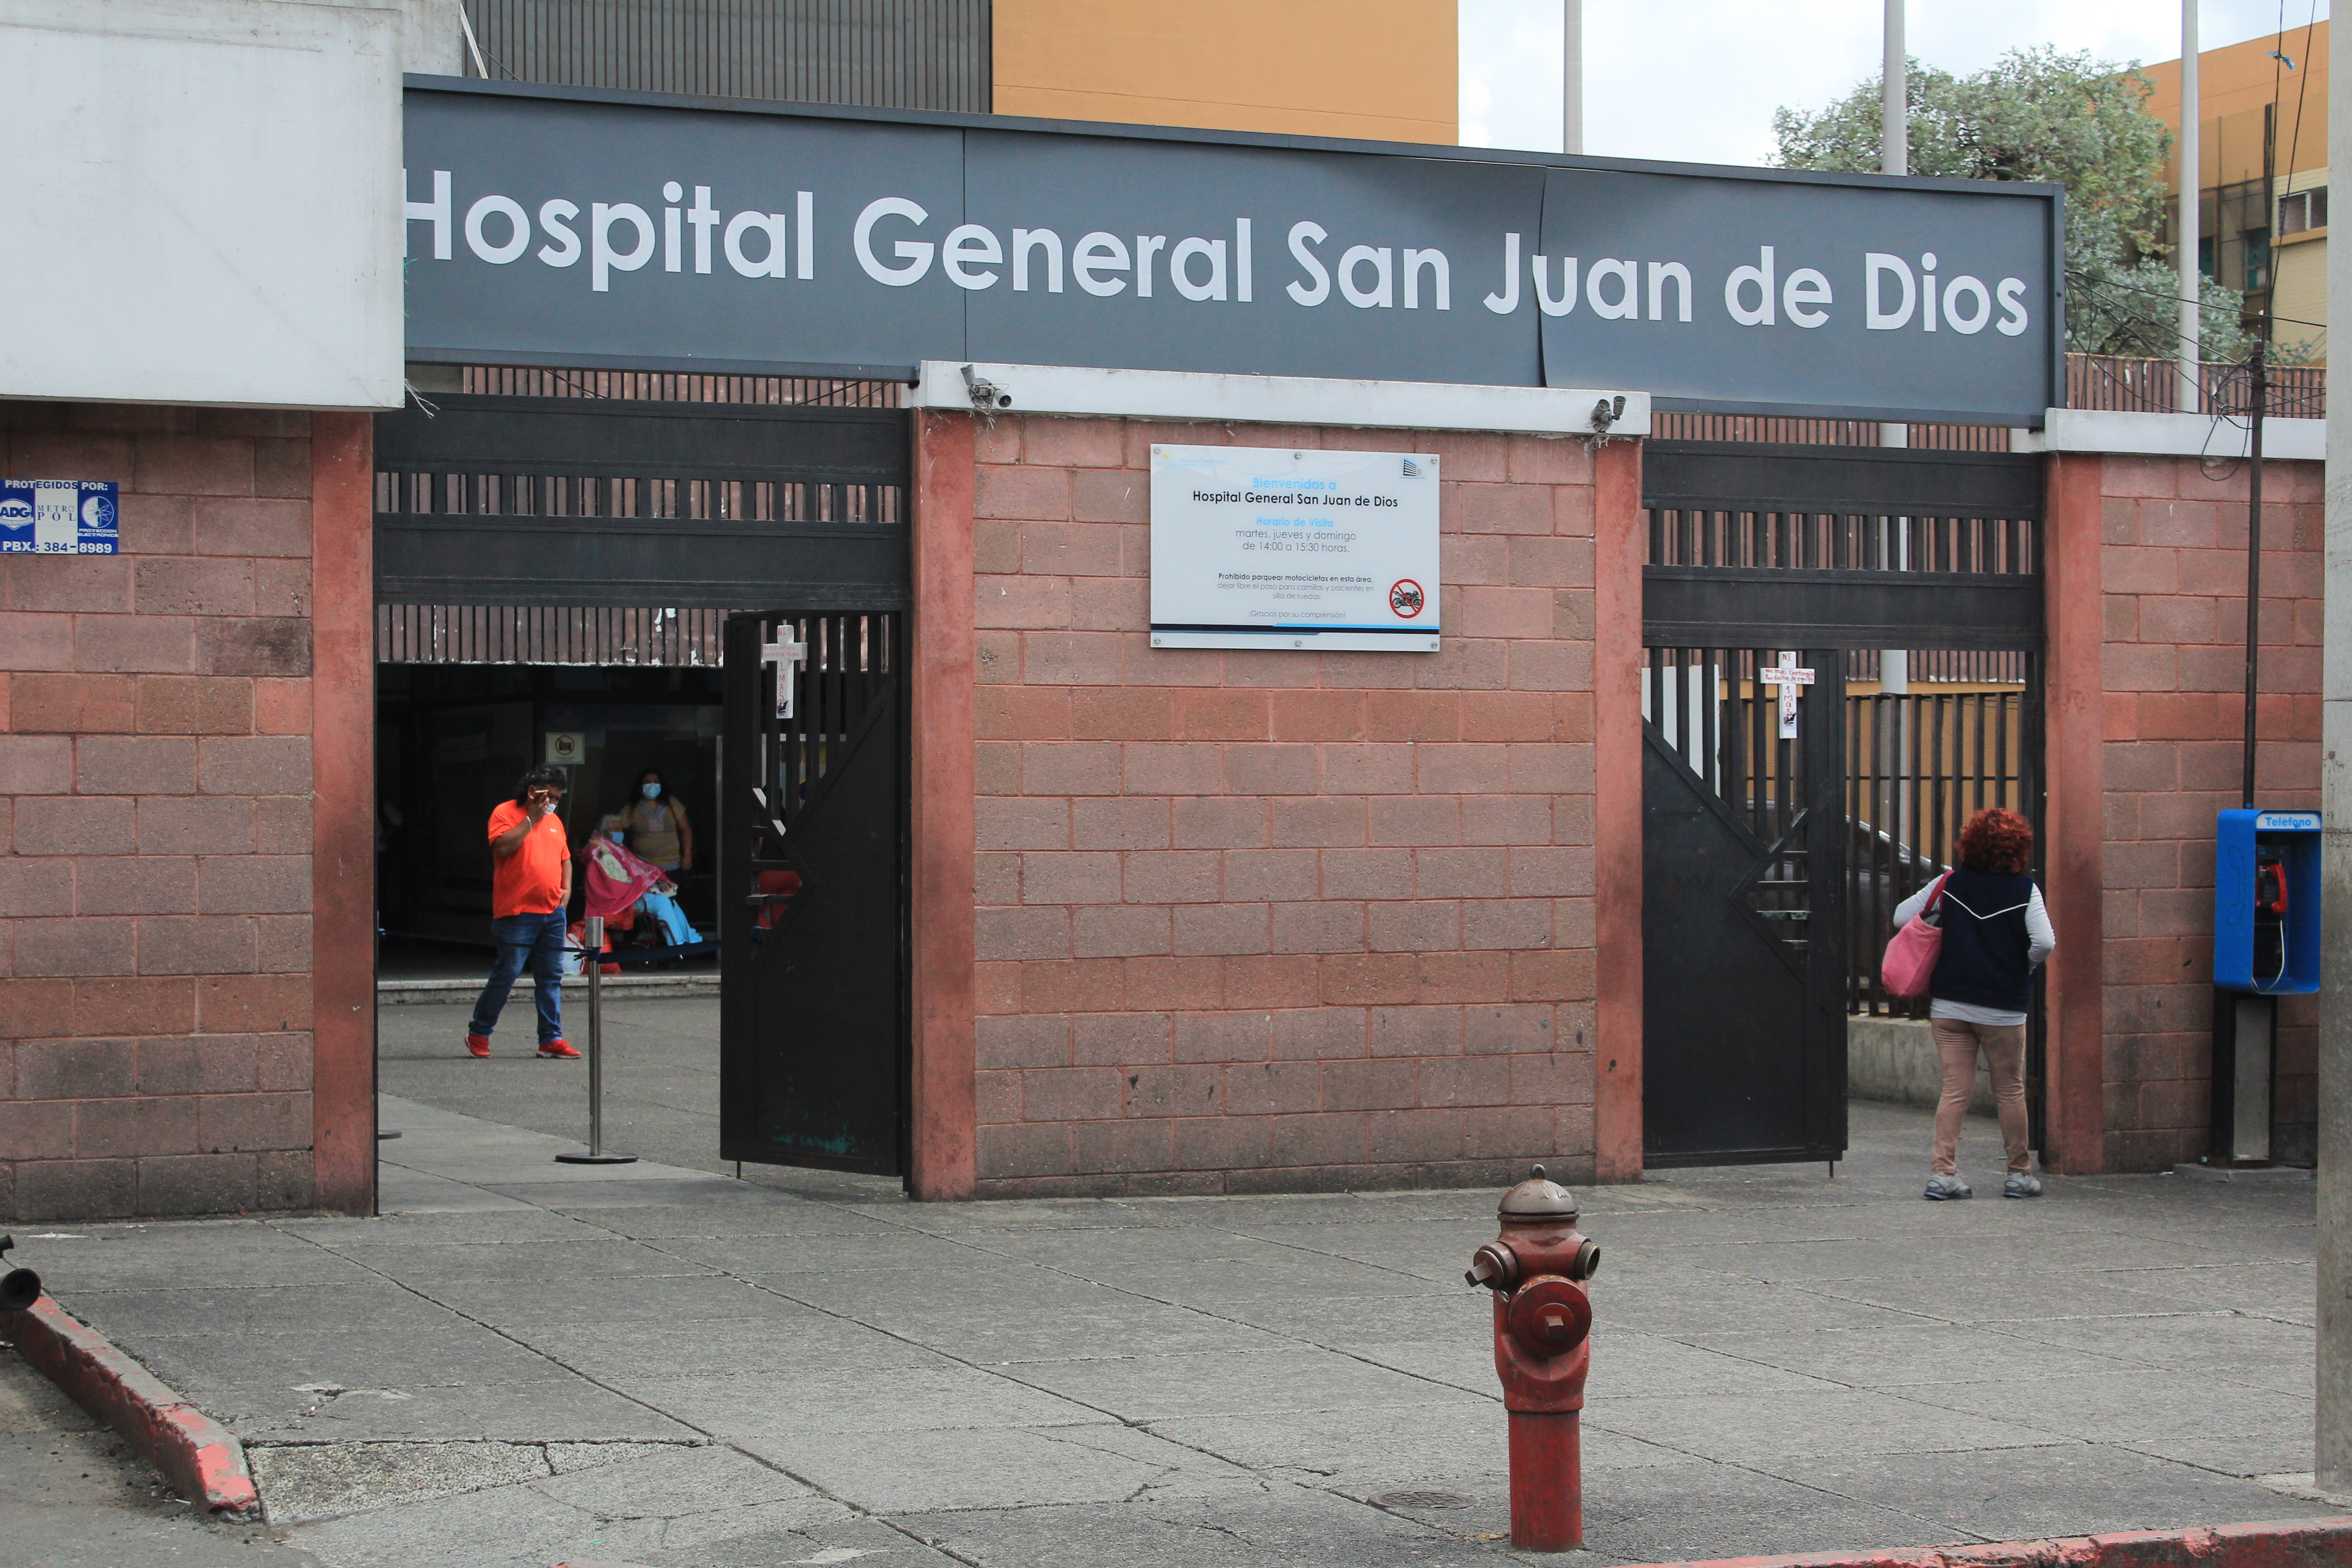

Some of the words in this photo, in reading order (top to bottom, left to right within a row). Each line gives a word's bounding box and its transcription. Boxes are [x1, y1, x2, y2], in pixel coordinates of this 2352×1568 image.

[403, 167, 814, 292] Hospital
[853, 196, 1252, 302] General
[1285, 220, 1450, 309] San
[1483, 232, 1693, 323] Juan
[1724, 245, 1833, 329] de
[1865, 251, 2029, 337] Dios
[5, 480, 78, 489] PROTEGIDOS
[82, 482, 108, 490] POR:
[1253, 477, 1325, 490] Bienvenidos
[1329, 482, 1336, 490] a
[1193, 491, 1241, 504] Hospital
[1245, 492, 1294, 504] General
[1297, 494, 1318, 505] San
[1323, 495, 1350, 505] Juan
[1355, 495, 1370, 506] de
[1374, 496, 1398, 507] Dios
[37, 512, 76, 521] POL
[1256, 517, 1290, 526] Horario
[1293, 518, 1306, 526] de
[1309, 519, 1333, 527] Visita
[1236, 529, 1270, 539] martes,
[1273, 530, 1303, 540] jueves
[1306, 533, 1311, 541] y
[1314, 531, 1356, 542] domingo
[1243, 542, 1255, 550] de
[1259, 542, 1283, 551] 14:00
[1296, 543, 1319, 551] 15:30
[1322, 544, 1350, 552] horas.
[2265, 816, 2312, 826] Teléfono
